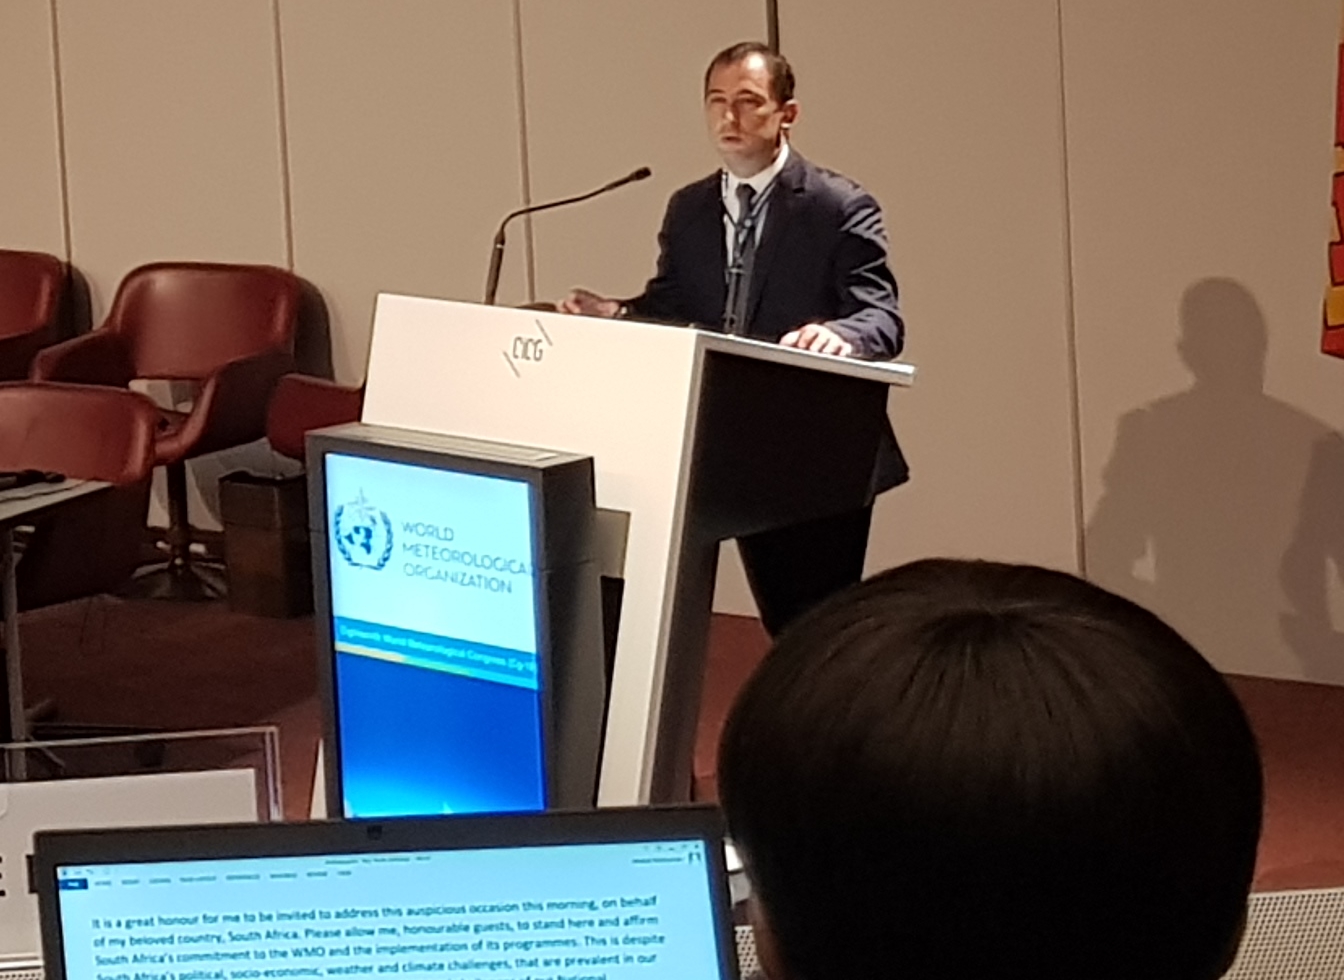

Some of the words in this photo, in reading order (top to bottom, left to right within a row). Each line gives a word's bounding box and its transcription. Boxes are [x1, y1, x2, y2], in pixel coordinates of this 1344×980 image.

[401, 521, 454, 541] WORLD
[403, 563, 513, 594] ORGANIZATION
[103, 919, 112, 929] is
[125, 916, 154, 931] great
[158, 914, 199, 926] honour
[202, 913, 218, 924] for
[222, 914, 240, 923] me
[243, 912, 256, 922] to
[258, 911, 273, 922] be
[276, 910, 316, 921] invited
[318, 910, 331, 920] to
[334, 908, 379, 919] address
[381, 907, 403, 918] this
[406, 904, 466, 917] auspicious
[469, 903, 519, 913] occasion
[522, 901, 543, 911] this
[546, 900, 598, 912] morning,
[602, 900, 617, 909] on
[620, 895, 657, 908] behalf
[94, 936, 105, 947] of
[109, 938, 125, 948] my
[130, 934, 174, 946] beloved
[228, 931, 262, 942] South
[305, 928, 341, 939] Please
[345, 926, 374, 937] allow
[403, 923, 470, 934] honourable
[517, 921, 529, 930] to
[533, 919, 564, 930] stand
[568, 917, 594, 927] here
[598, 917, 619, 927] and
[623, 914, 658, 926] affirm
[95, 955, 128, 966] South
[177, 950, 250, 962] commitment
[254, 950, 266, 959] to
[269, 948, 288, 958] the
[292, 946, 325, 957] WMO
[329, 945, 350, 956] and
[353, 945, 372, 955] the
[376, 942, 468, 955] implementation
[471, 940, 483, 951] of
[486, 941, 499, 950] its
[584, 935, 607, 946] This
[610, 936, 619, 945] is
[622, 933, 665, 946] despite
[327, 964, 373, 975] weather
[378, 962, 399, 973] and
[402, 961, 444, 972] climate
[515, 958, 538, 968] that
[543, 958, 561, 967] are
[565, 954, 620, 967] prevalent
[623, 953, 634, 963] in
[637, 954, 657, 963] our
